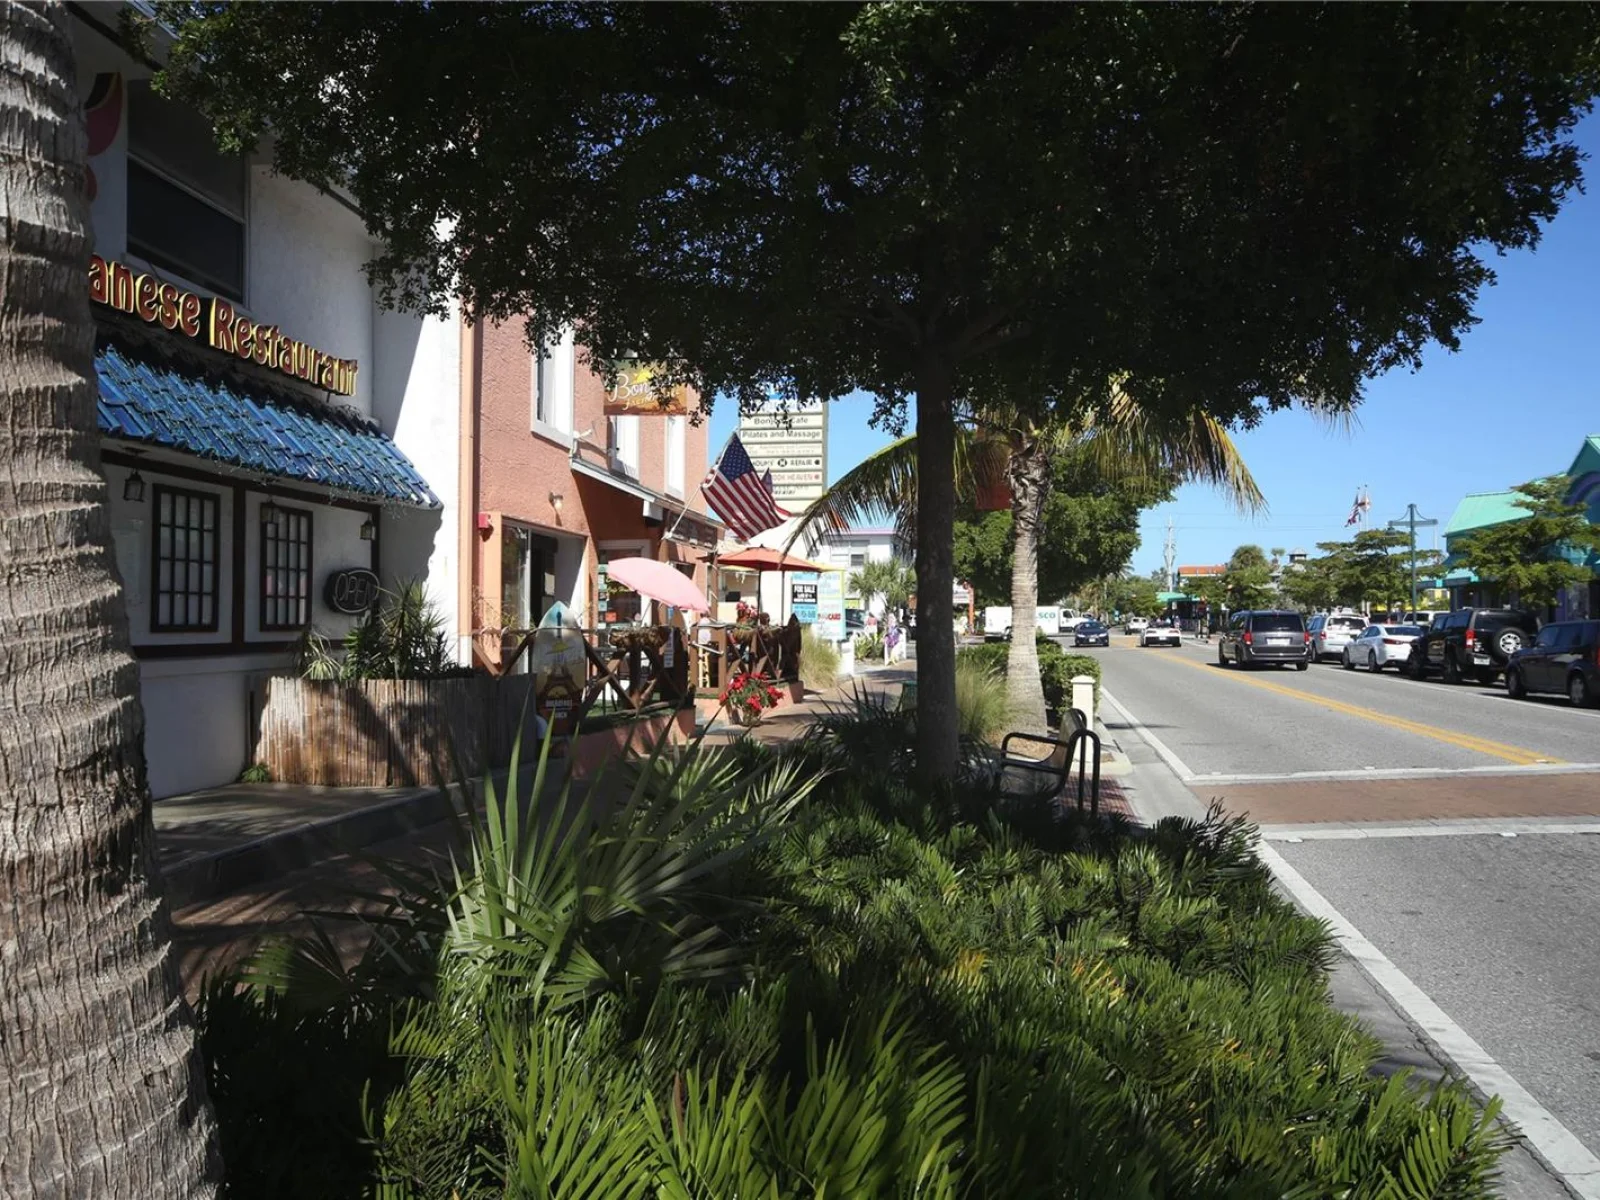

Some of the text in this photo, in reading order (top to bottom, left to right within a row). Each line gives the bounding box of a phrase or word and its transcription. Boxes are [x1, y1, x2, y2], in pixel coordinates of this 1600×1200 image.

[88, 253, 358, 397] anese Restaurant
[607, 373, 652, 402] Bon
[787, 430, 820, 439] Massage
